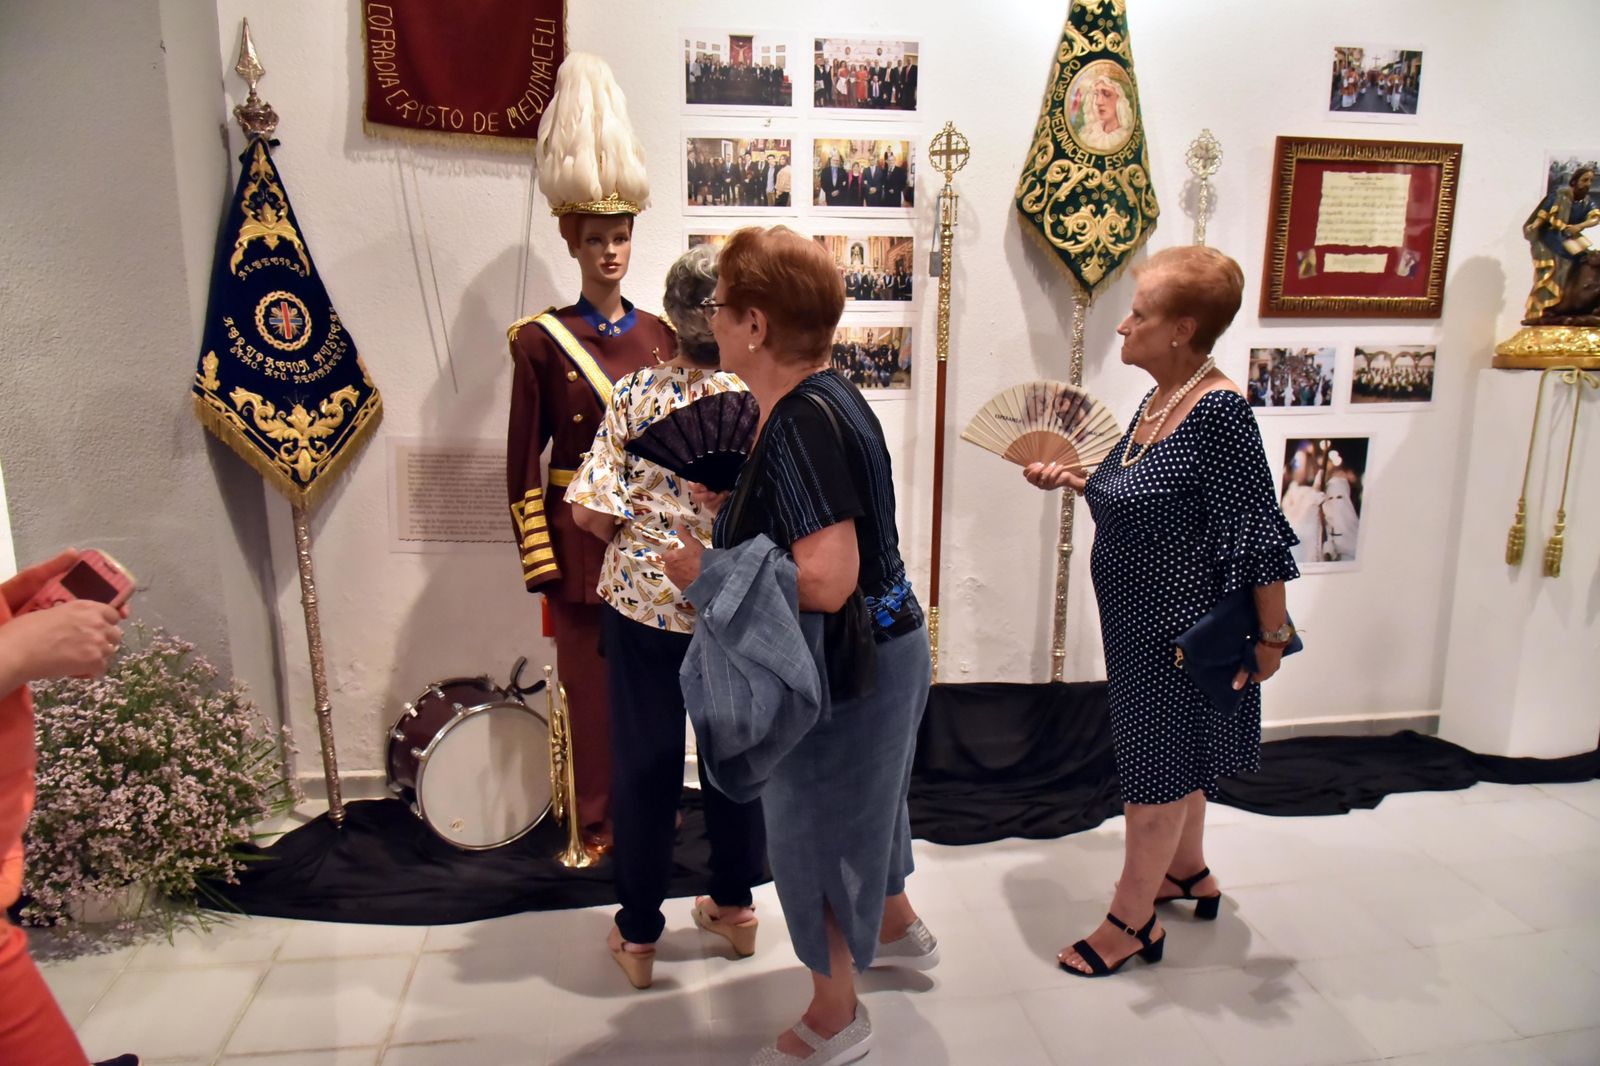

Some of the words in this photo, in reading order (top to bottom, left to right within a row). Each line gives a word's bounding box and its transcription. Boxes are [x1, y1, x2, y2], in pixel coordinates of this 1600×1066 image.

[368, 3, 401, 88] COFRADIA
[385, 89, 464, 129] CRISTO
[473, 111, 499, 132] DE
[506, 17, 556, 129] MEDINACELI
[1053, 59, 1081, 101] GRUPO
[1051, 107, 1096, 167] MEDINACELI
